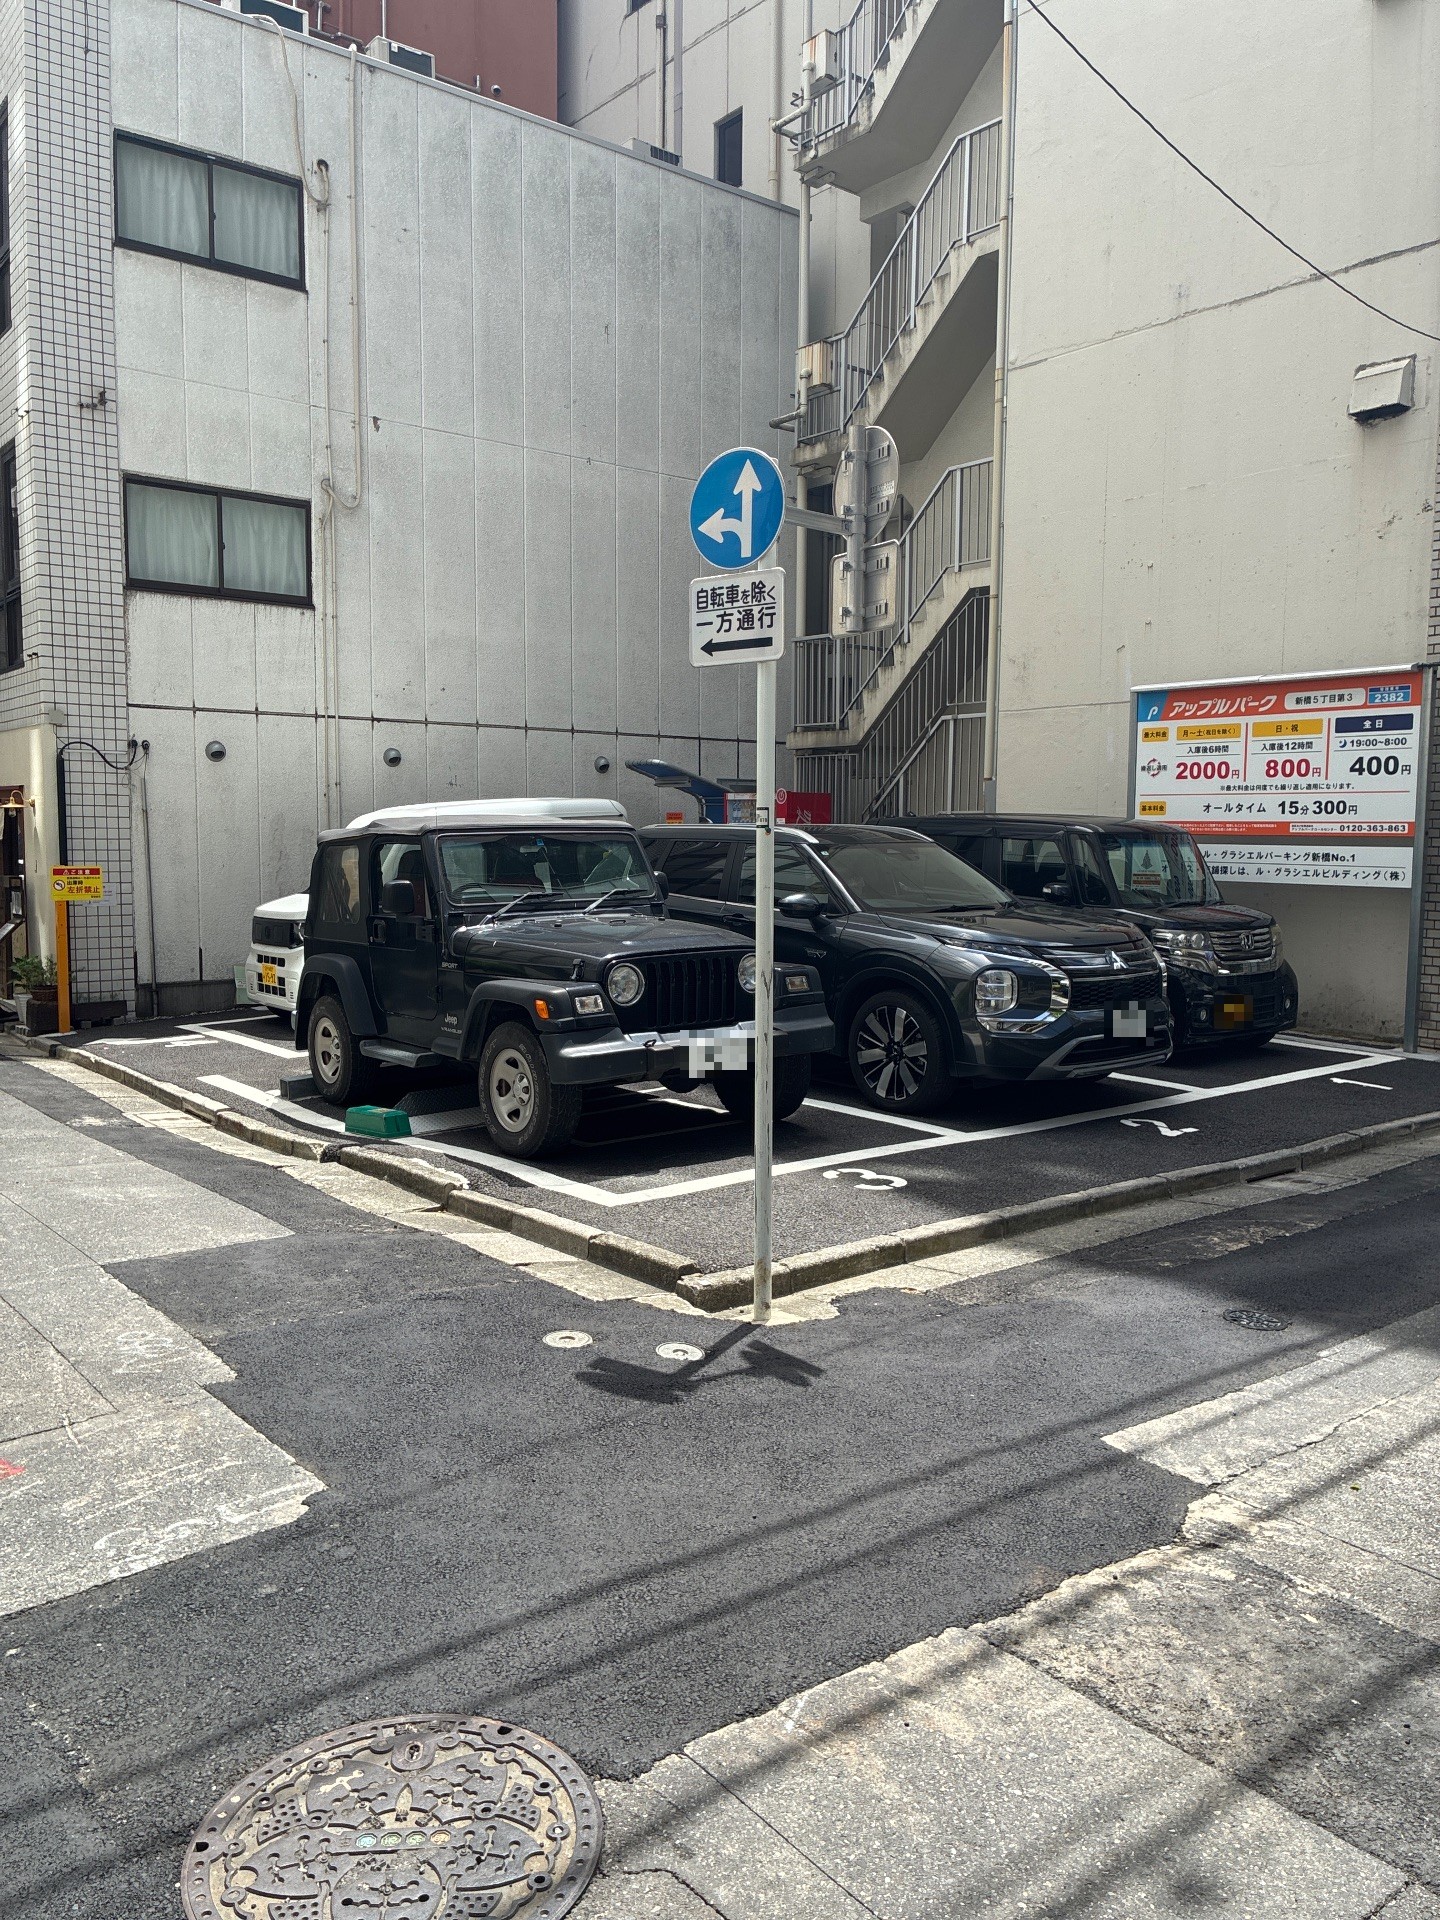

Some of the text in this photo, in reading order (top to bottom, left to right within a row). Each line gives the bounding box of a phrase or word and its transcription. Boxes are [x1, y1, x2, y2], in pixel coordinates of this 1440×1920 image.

[696, 580, 776, 610] 自転車を除く
[696, 605, 777, 634] 一方通行
[1295, 693, 1353, 706] 新橋5丁目第3
[1374, 692, 1404, 703] 2382
[1168, 695, 1278, 718] アップルパーク
[1363, 719, 1383, 729] 全日
[1143, 731, 1168, 739] 最大料金
[1187, 745, 1229, 754] 入庫後6時間
[1261, 741, 1314, 751] 入庫後12時間
[1175, 761, 1240, 780] 2000円
[1265, 758, 1322, 778] 800円
[1349, 756, 1412, 776] 400円
[1203, 802, 1267, 814] オールタイム
[67, 885, 101, 894] 左折禁止
[441, 961, 458, 969] SPORT
[444, 1012, 458, 1027] Jeep
[1119, 1118, 1200, 1137] 2
[822, 1168, 908, 1191] 3
